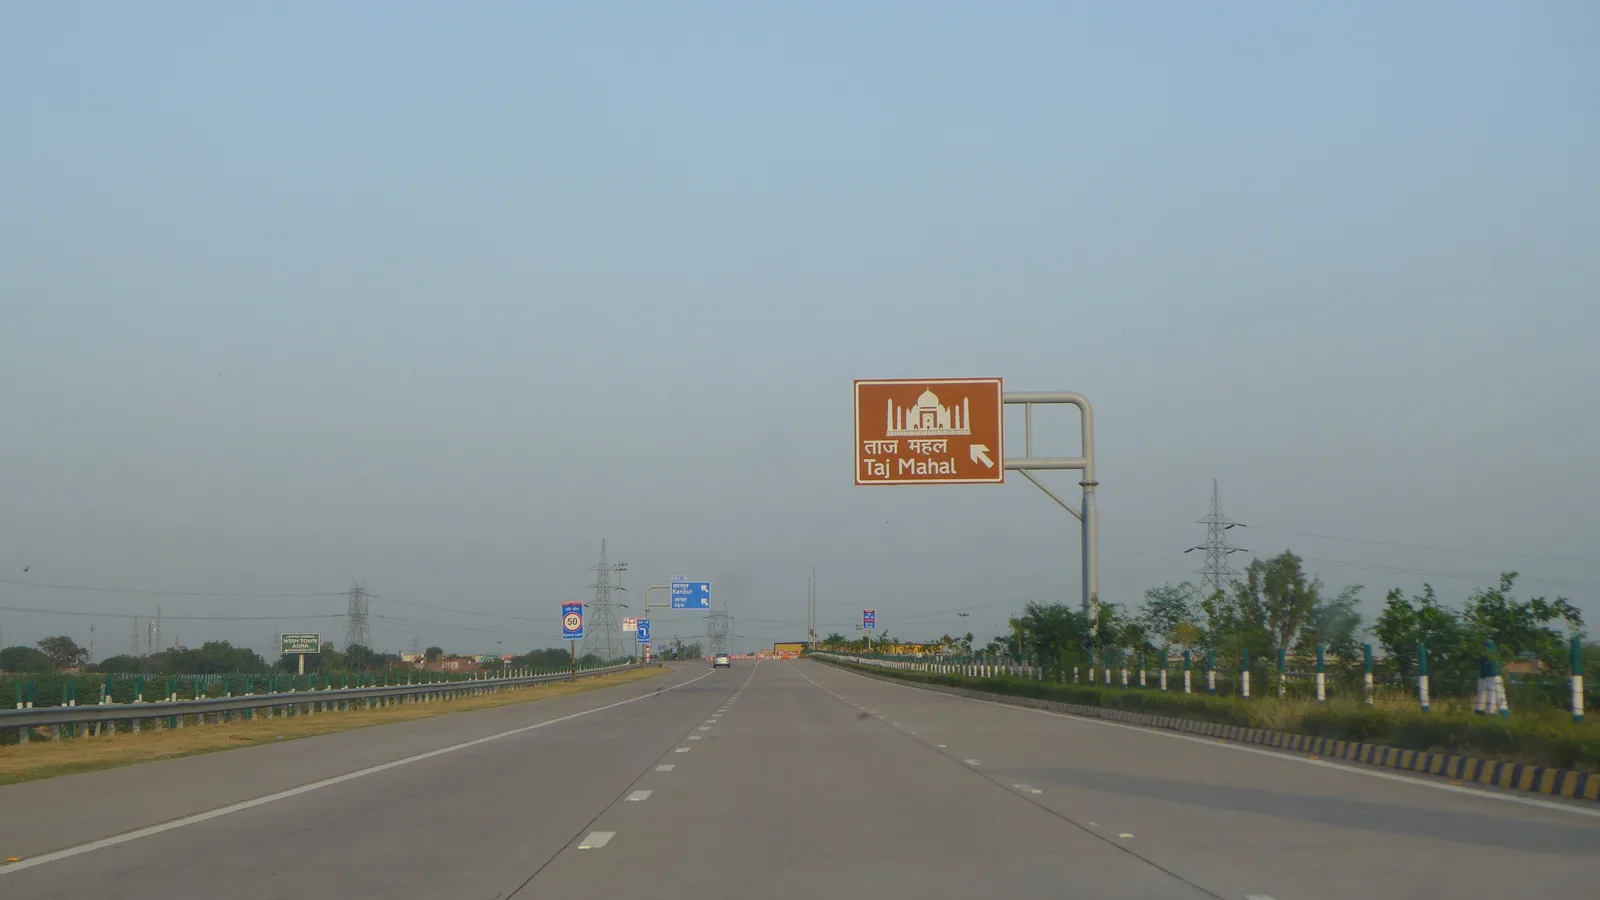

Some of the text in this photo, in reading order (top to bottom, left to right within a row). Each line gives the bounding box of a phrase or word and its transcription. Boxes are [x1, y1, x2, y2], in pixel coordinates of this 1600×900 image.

[863, 439, 948, 455] ताज महल
[863, 457, 957, 479] Taj Mahal
[567, 617, 578, 626] 50
